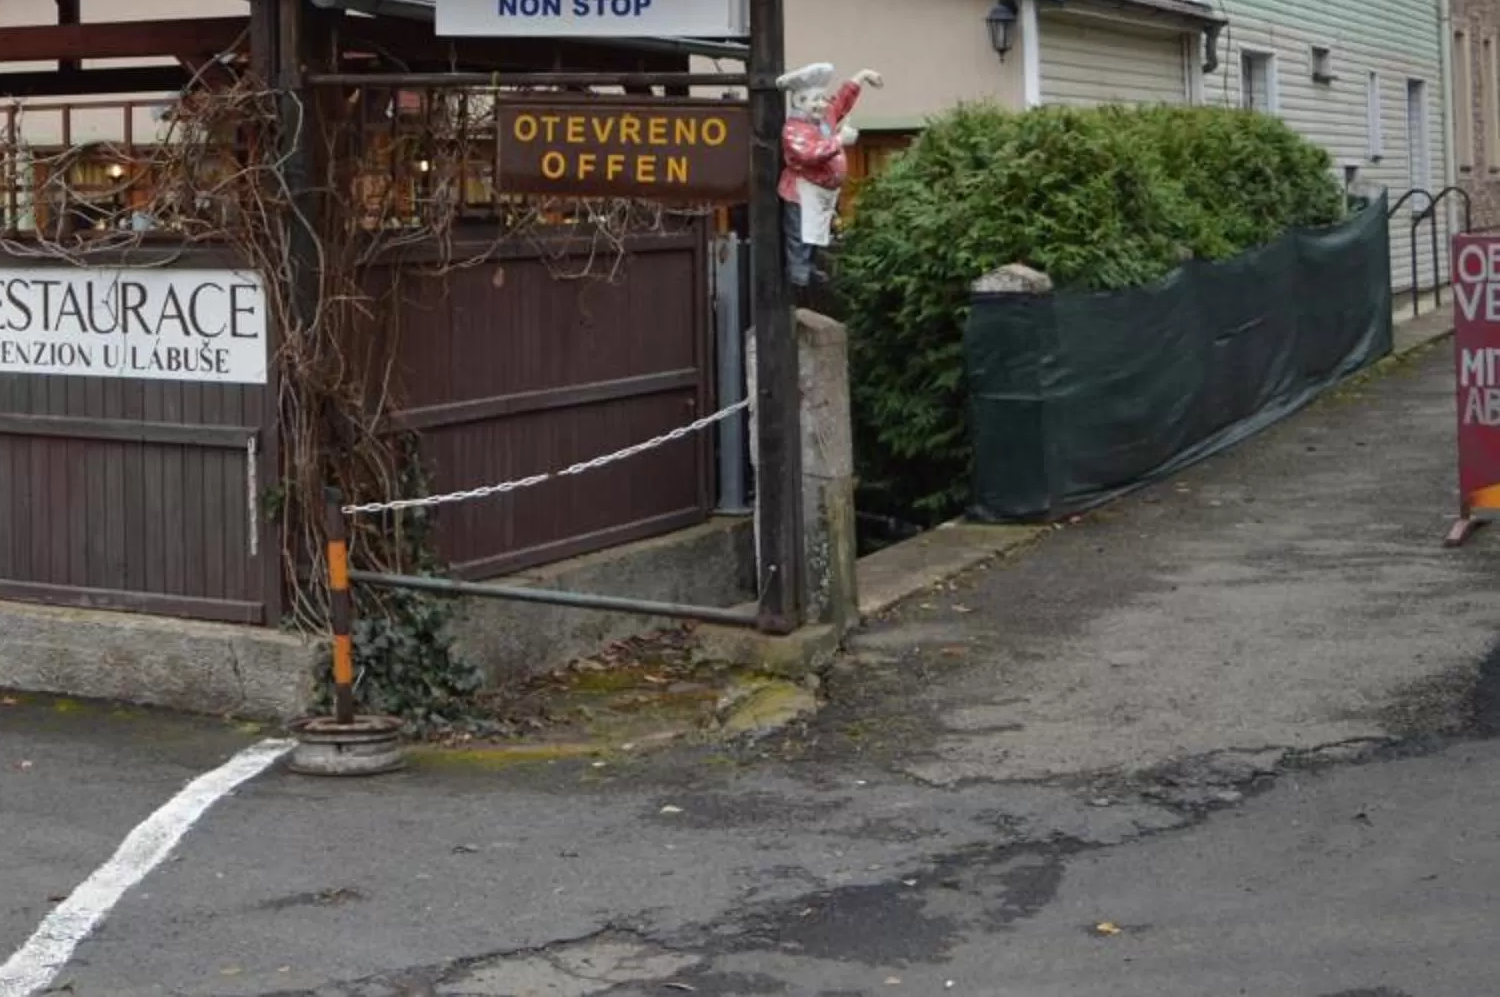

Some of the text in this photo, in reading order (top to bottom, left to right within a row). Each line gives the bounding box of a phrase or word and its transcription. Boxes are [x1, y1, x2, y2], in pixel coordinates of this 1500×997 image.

[513, 113, 728, 146] OTEVŘENO
[541, 151, 689, 184] OFFEN
[103, 344, 119, 369] U
[131, 338, 230, 374] LÁBUŠE
